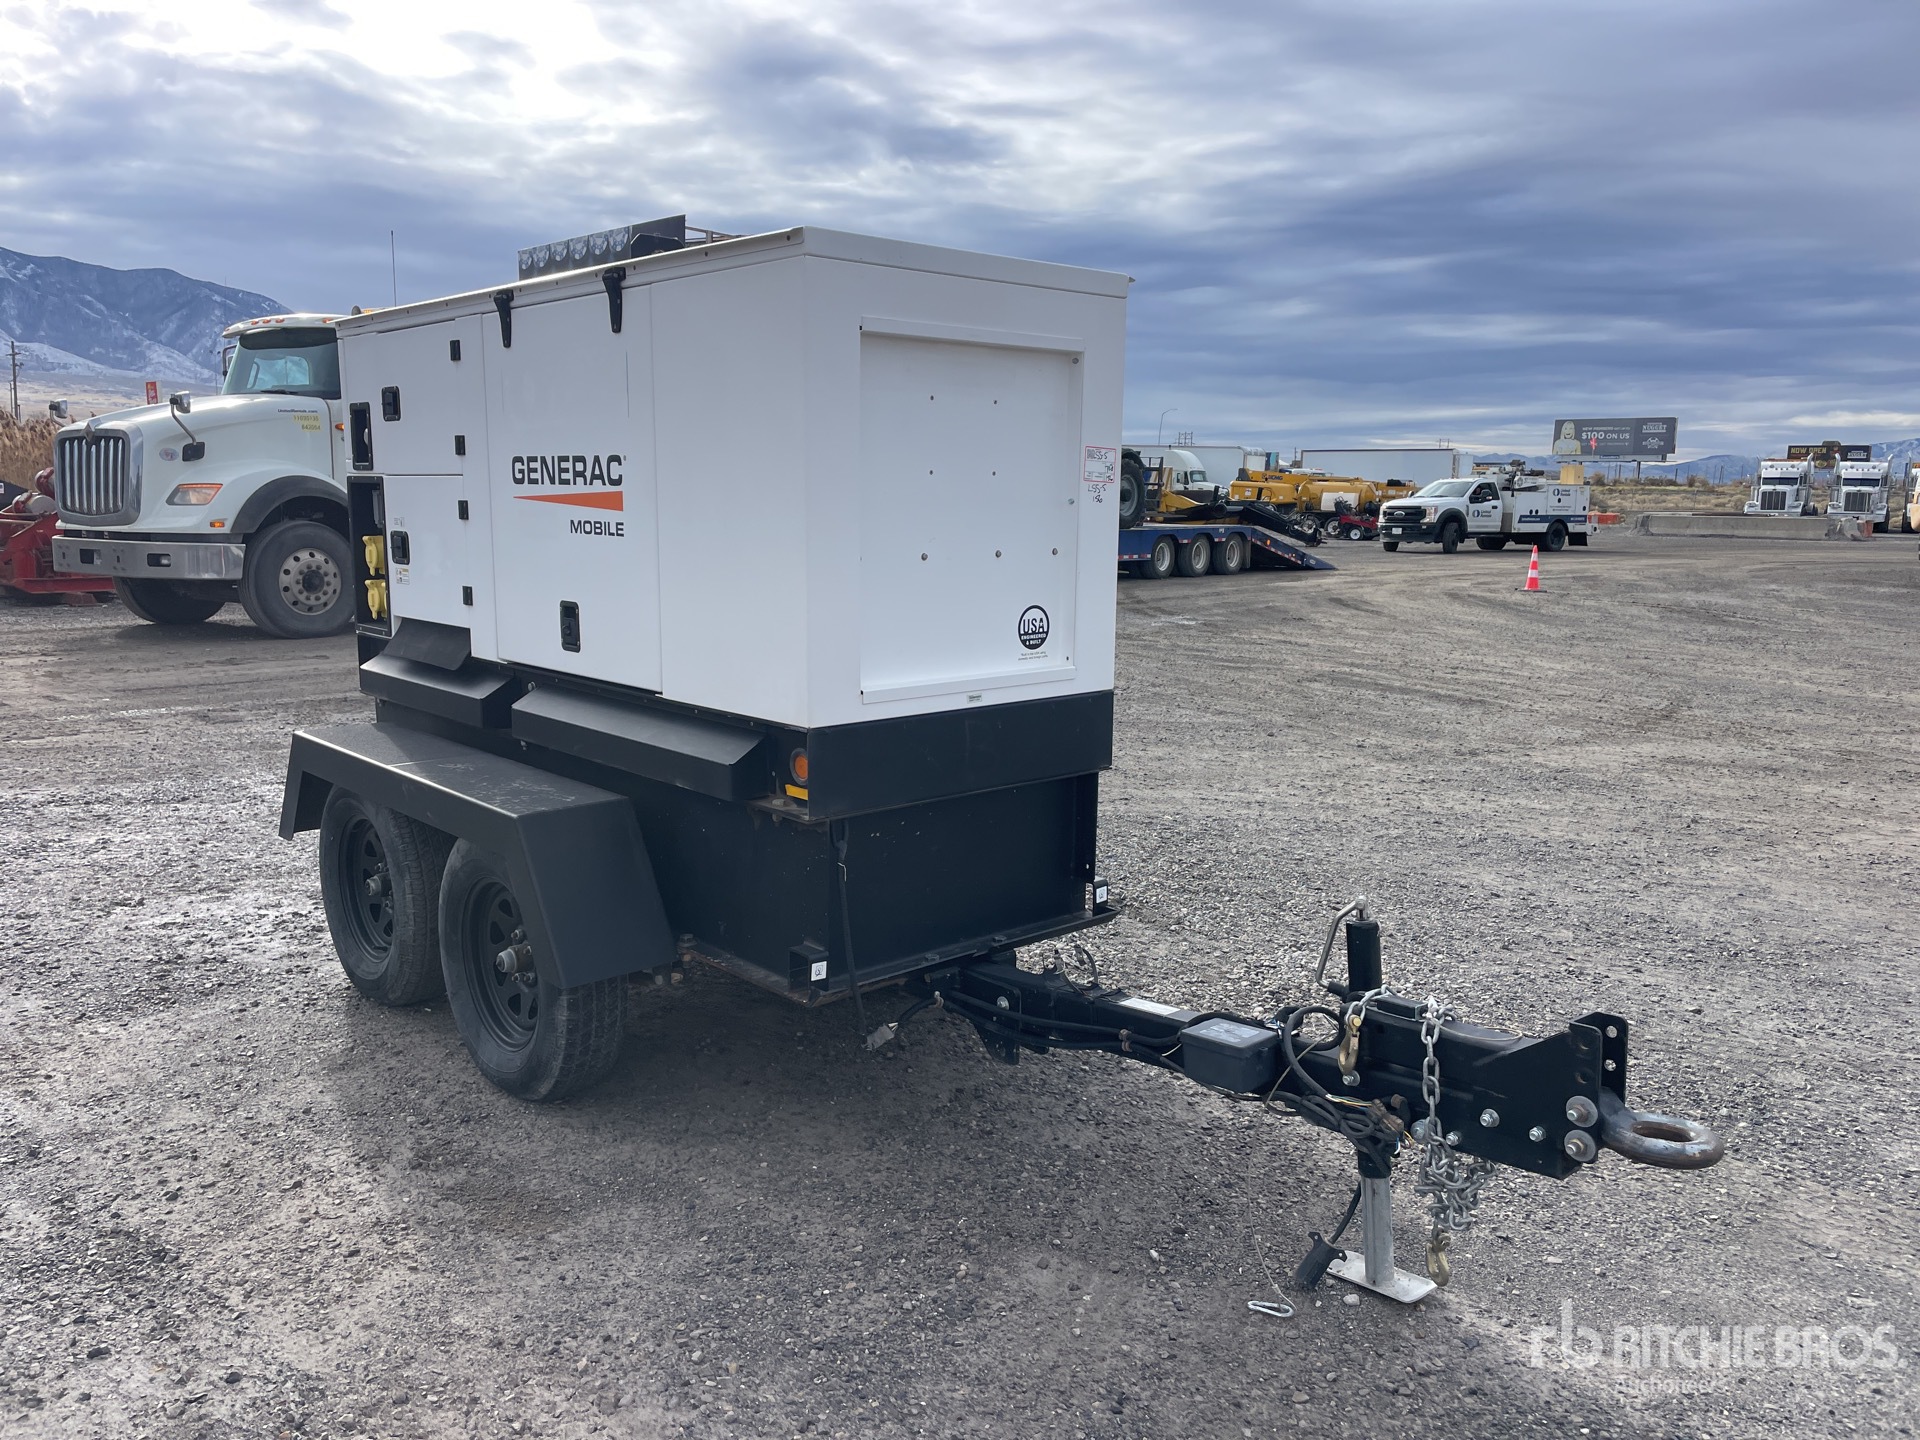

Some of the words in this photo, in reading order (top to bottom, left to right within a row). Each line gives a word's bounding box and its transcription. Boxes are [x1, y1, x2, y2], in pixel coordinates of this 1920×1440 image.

[511, 454, 623, 486] GENERAC
[570, 519, 625, 537] MOBILE
[1023, 618, 1045, 632] USA
